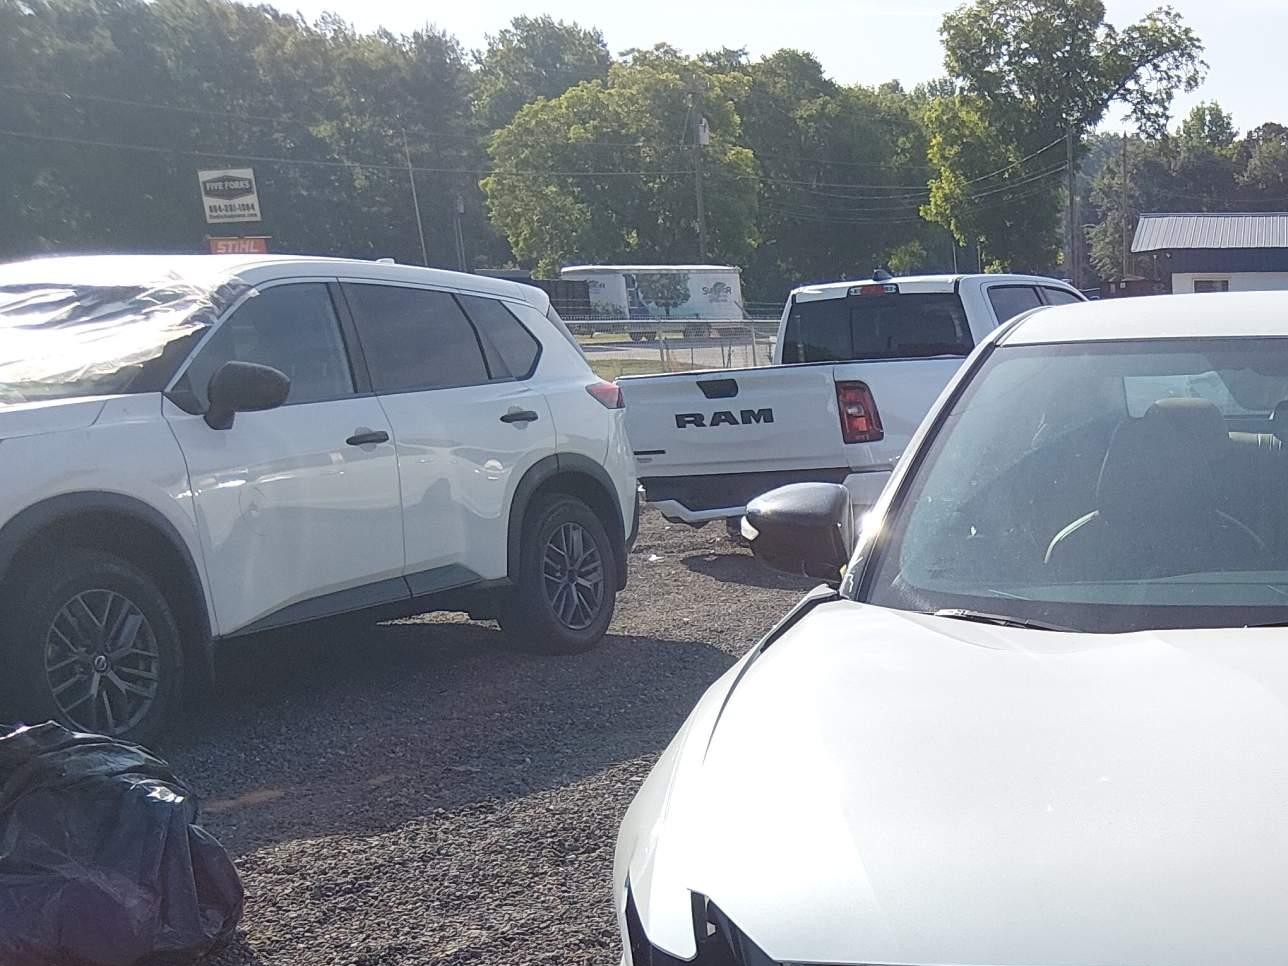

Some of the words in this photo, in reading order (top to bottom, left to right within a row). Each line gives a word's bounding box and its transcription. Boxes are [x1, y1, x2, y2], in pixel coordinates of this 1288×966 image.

[206, 182, 224, 190] FIVE
[224, 180, 250, 189] FORKS
[217, 240, 257, 253] STIHL
[676, 408, 774, 428] RAM
